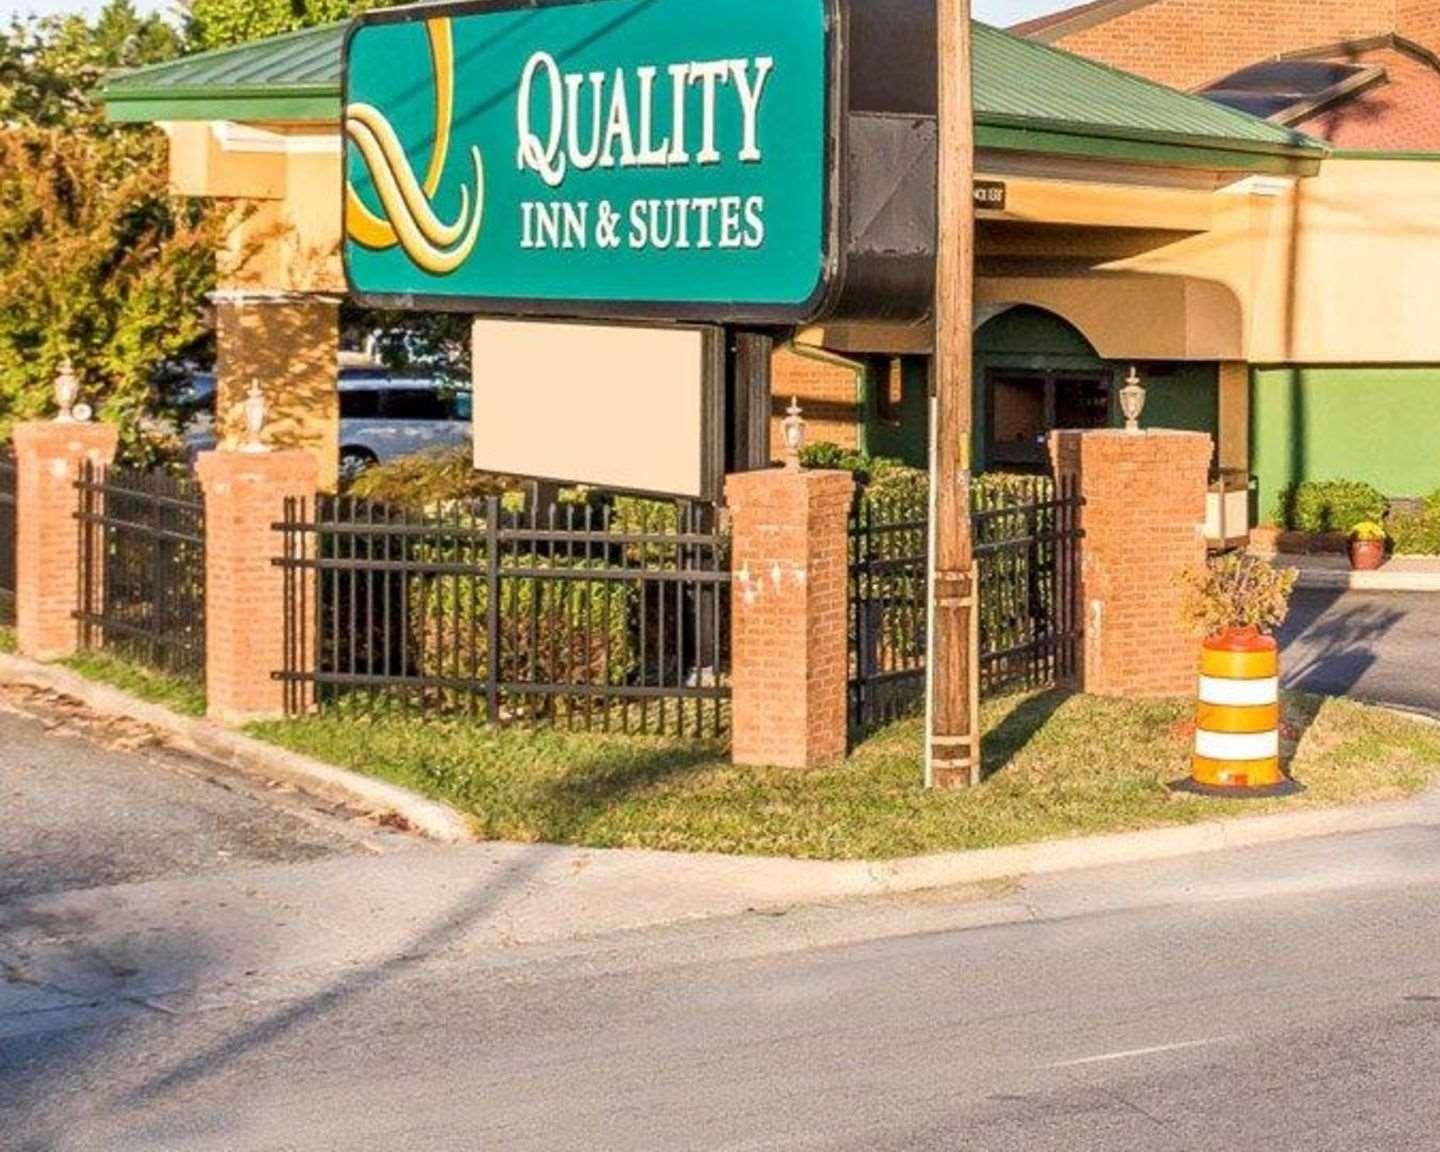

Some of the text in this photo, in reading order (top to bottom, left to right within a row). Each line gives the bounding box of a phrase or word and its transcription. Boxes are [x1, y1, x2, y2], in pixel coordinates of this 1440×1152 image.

[517, 51, 773, 186] QUALITY
[520, 196, 764, 248] INN & SUITES
